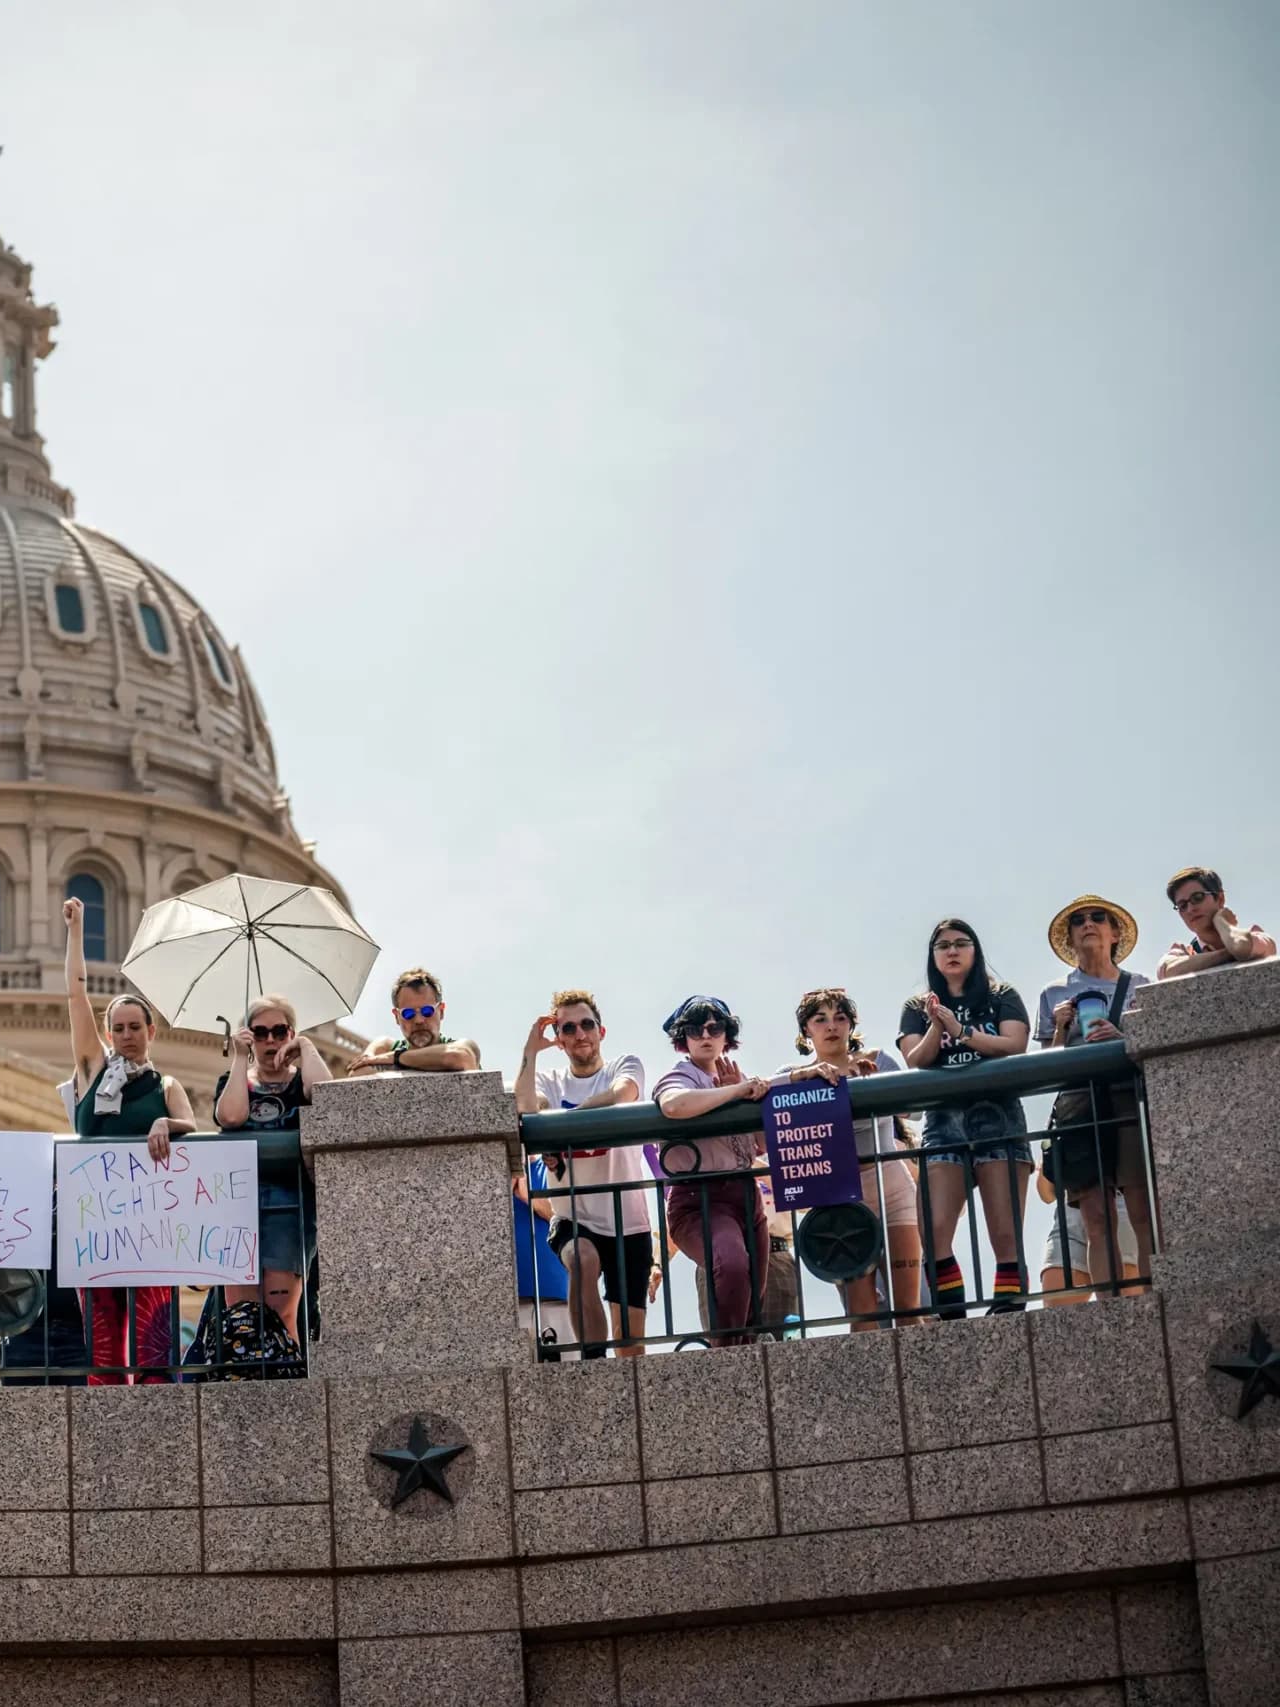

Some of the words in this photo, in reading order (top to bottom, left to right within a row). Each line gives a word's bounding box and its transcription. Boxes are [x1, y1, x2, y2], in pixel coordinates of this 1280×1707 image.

[948, 1052, 982, 1064] KIDS
[772, 1087, 836, 1109] ORGANIZE
[773, 1111, 791, 1126] TO
[776, 1123, 833, 1144] PROTECT
[778, 1143, 823, 1162] TRANS
[780, 1160, 832, 1180] TEXANS
[76, 1179, 179, 1229] RIGHTS
[195, 1168, 252, 1205] ARE
[784, 1186, 804, 1195] ACLU
